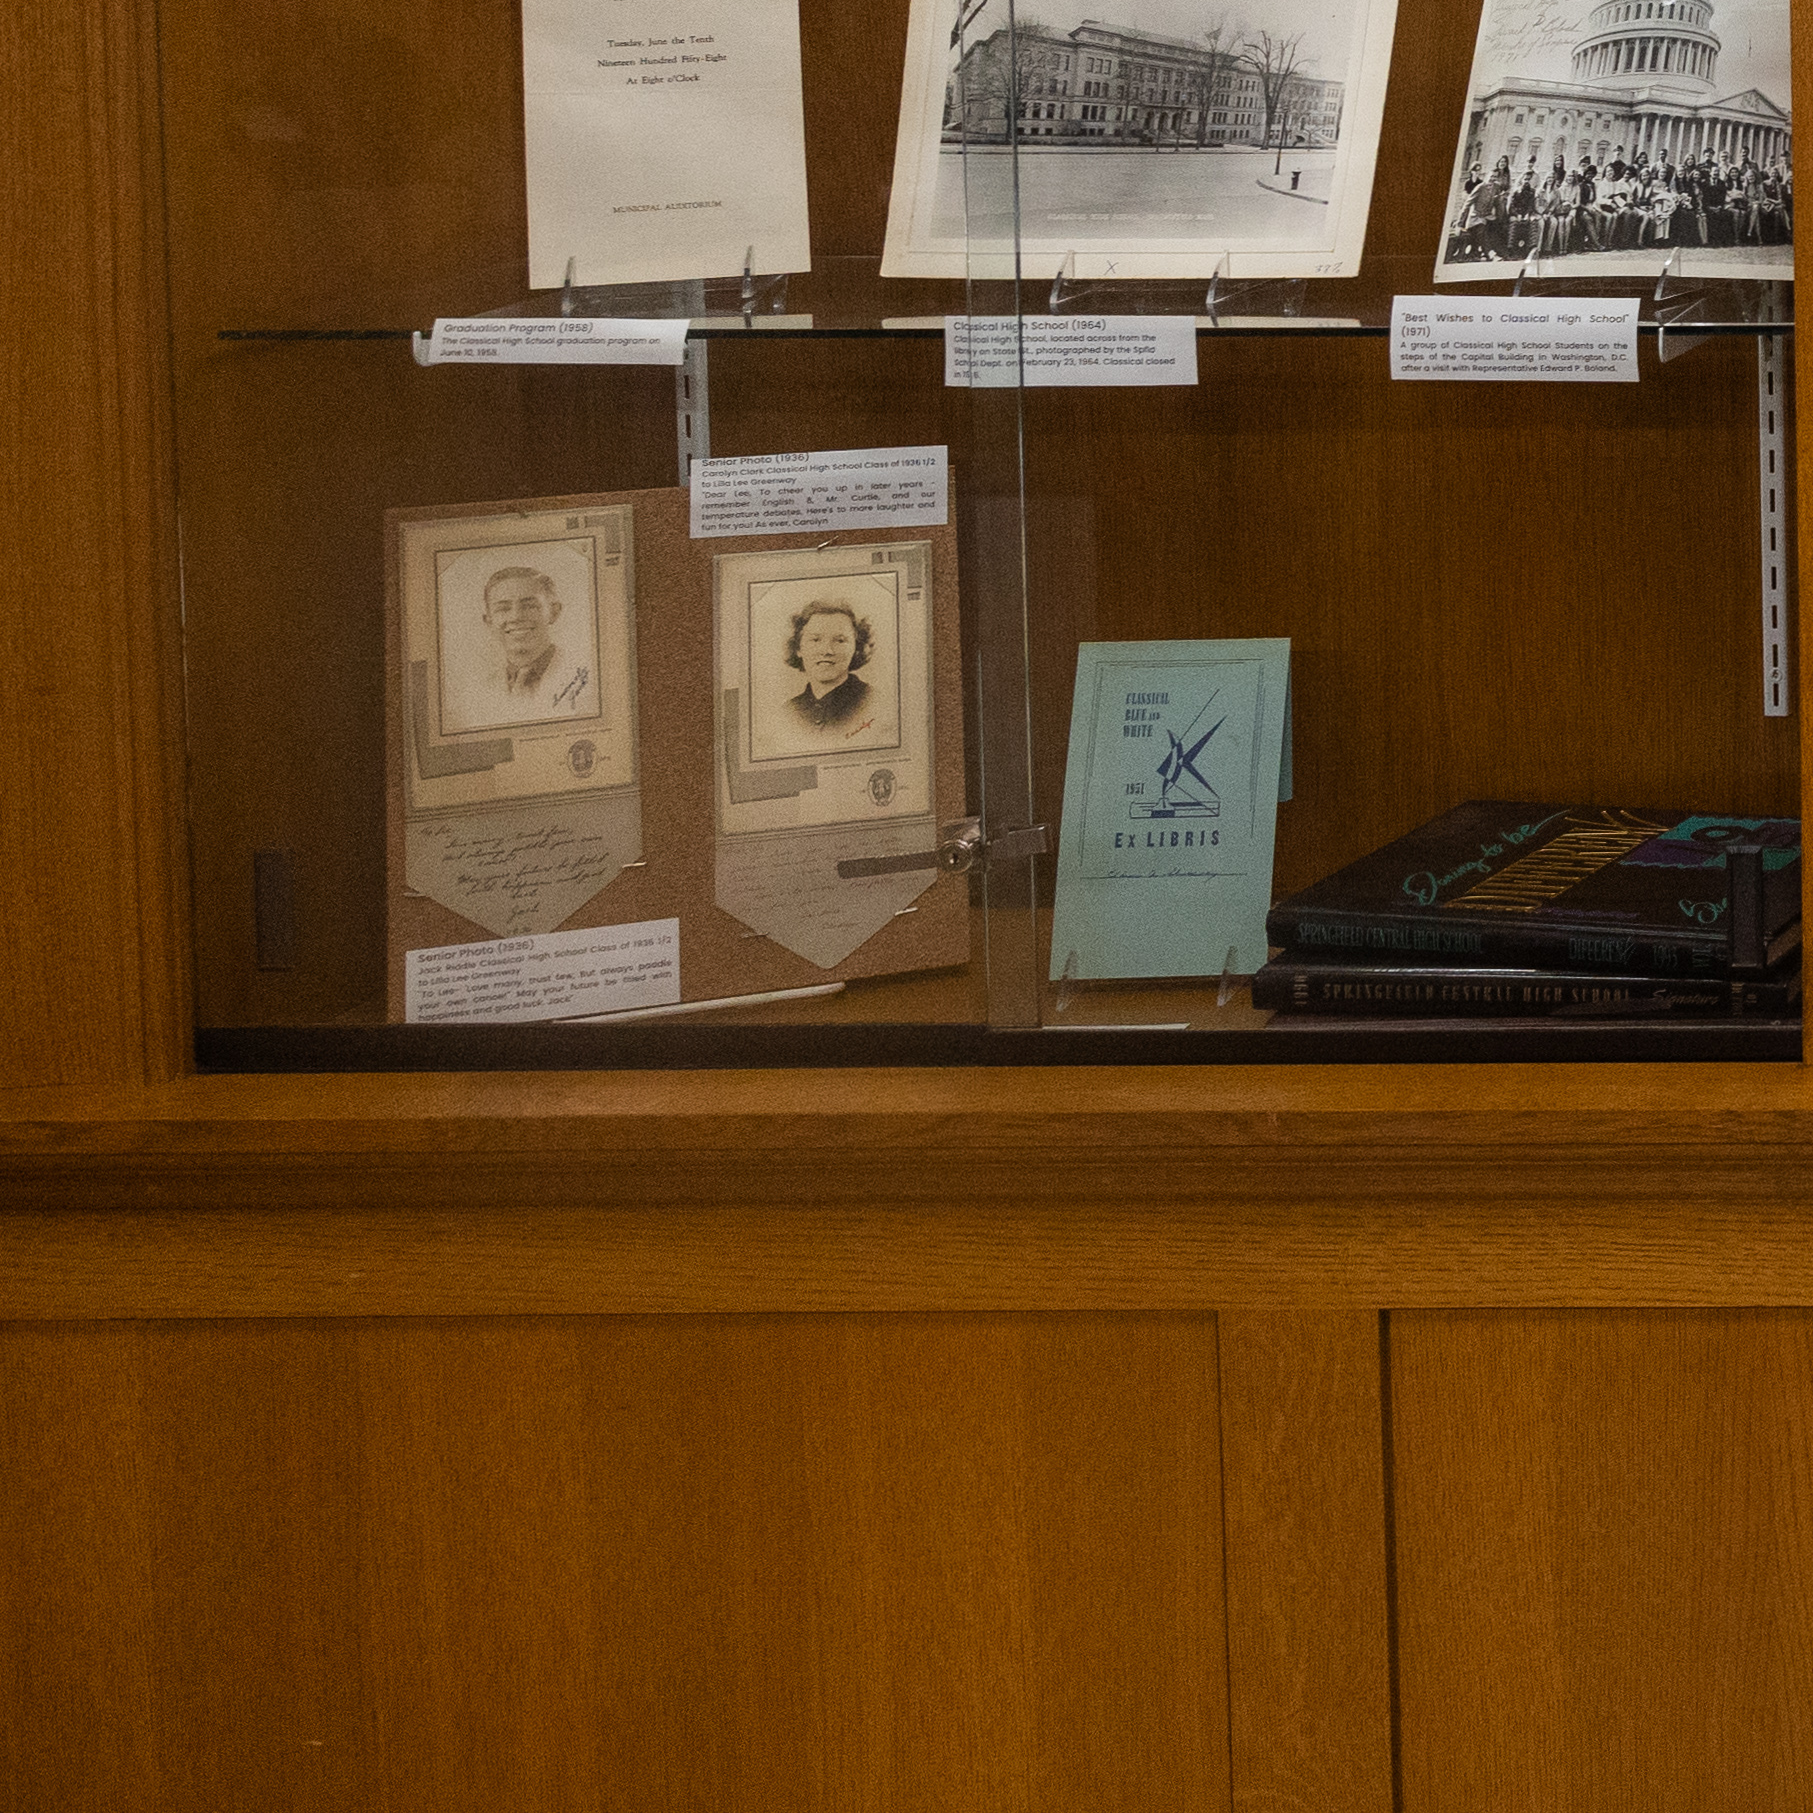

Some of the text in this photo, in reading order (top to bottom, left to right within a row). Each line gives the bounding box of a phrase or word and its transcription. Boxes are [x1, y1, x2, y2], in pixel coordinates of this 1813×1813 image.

[953, 317, 998, 333] Classical
[1031, 320, 1069, 330] School
[1436, 313, 1473, 322] Wishes
[1482, 314, 1492, 322] to
[1500, 313, 1549, 323] Classical
[1557, 314, 1581, 325] High
[444, 321, 593, 335] Graduation Program (1958)
[1401, 325, 1430, 338] (1971)
[701, 452, 810, 468] Senior Photo (1936)
[1125, 692, 1169, 705] CLASSICAL
[1125, 708, 1147, 721] BLUE
[1123, 724, 1153, 737] WHITE
[1147, 830, 1220, 847] LIBRIS
